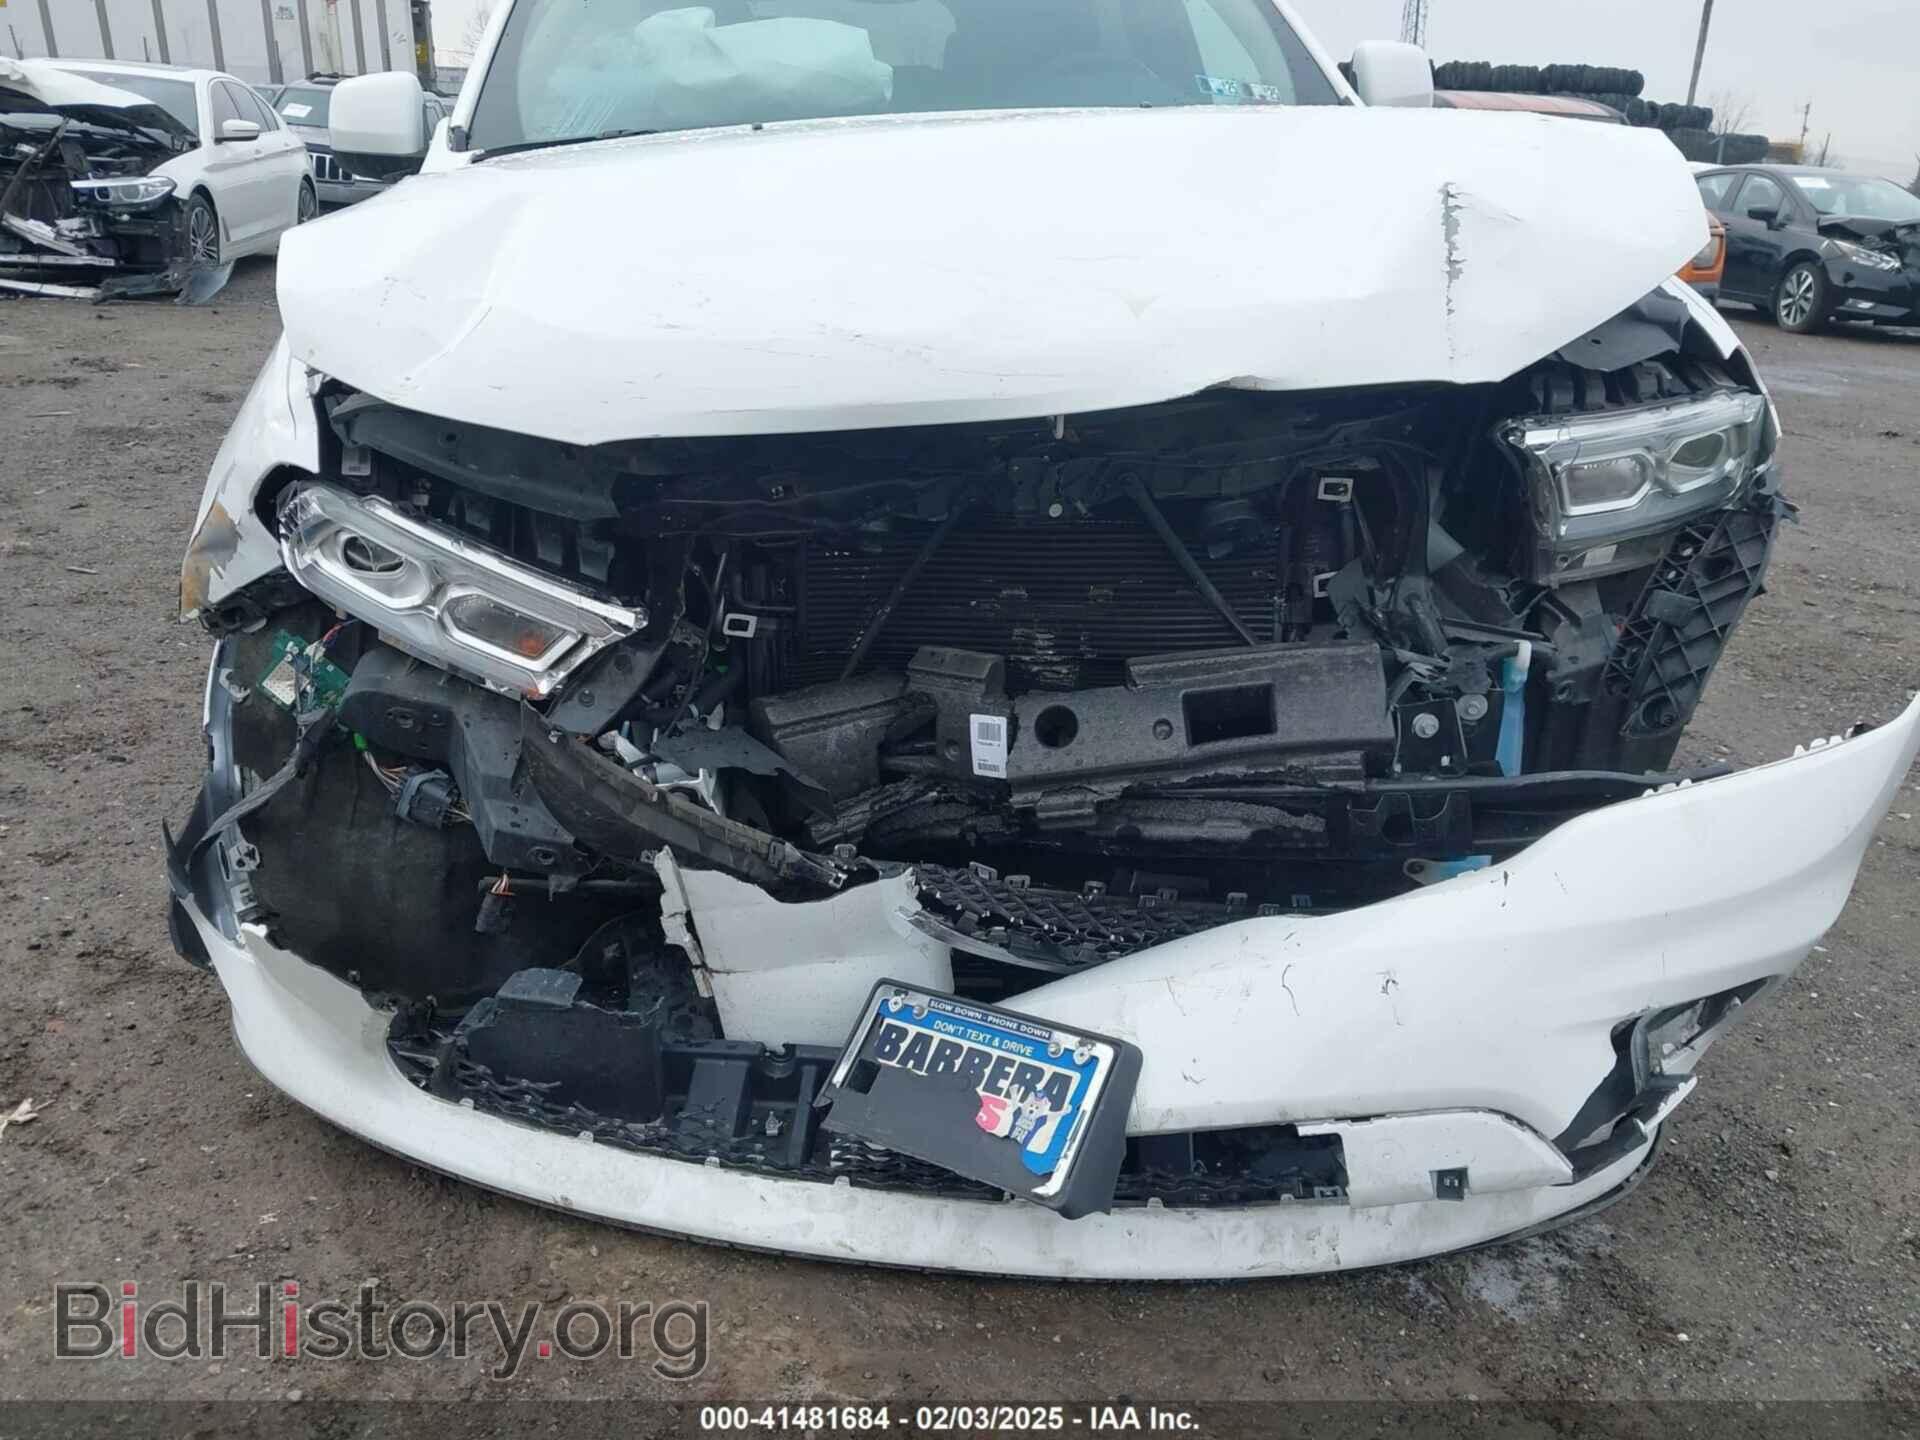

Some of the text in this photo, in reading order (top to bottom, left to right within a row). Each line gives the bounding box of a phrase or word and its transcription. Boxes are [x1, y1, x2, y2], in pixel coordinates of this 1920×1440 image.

[930, 1000, 953, 1012] SLOW
[955, 1006, 982, 1019] DOWN
[987, 1015, 1018, 1030] PHONE
[1020, 1024, 1050, 1038] DOWN
[933, 1020, 964, 1035] DON'T
[966, 1028, 990, 1044] TEXT
[1002, 1040, 1035, 1057] DRIVE
[875, 1022, 1073, 1112] BARBERA
